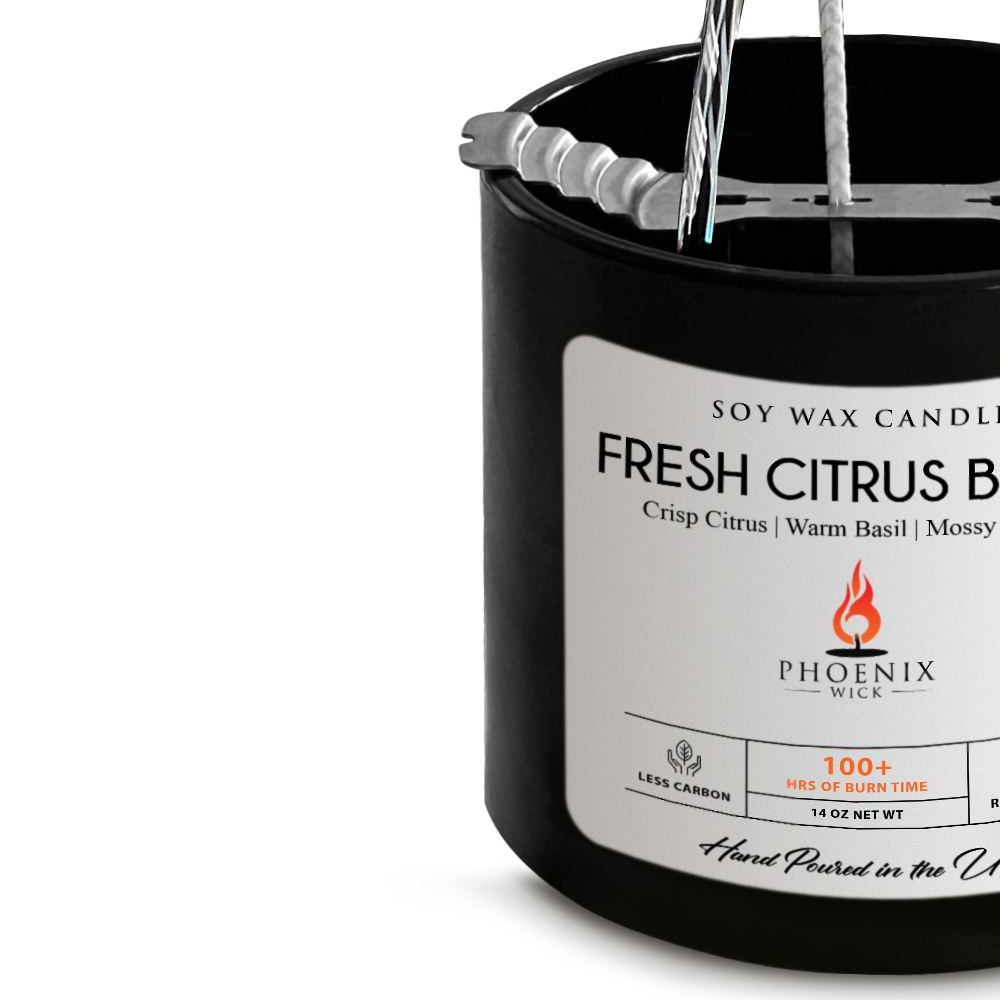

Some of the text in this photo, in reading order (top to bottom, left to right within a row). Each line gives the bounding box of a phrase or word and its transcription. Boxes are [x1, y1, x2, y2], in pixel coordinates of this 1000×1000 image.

[712, 399, 774, 423] SOY
[789, 406, 858, 428] WAX
[598, 431, 748, 496] FRESH
[766, 457, 949, 503] CITRUS
[642, 500, 699, 528] Crisp
[705, 510, 768, 533] Citrus
[785, 517, 847, 537] Warm
[854, 519, 907, 538] Basil
[925, 518, 997, 539] Mossy
[778, 659, 935, 685] PHOENIX
[830, 686, 883, 699] WICK
[822, 756, 892, 777] 100+
[637, 771, 732, 803] LESS CARBON
[786, 778, 928, 793] HRS OF BURN TIME
[811, 808, 904, 821] 14 OZ NET WT
[699, 836, 781, 868] Hand
[784, 847, 874, 878] Poured
[875, 862, 903, 878] in
[909, 860, 946, 880] the
